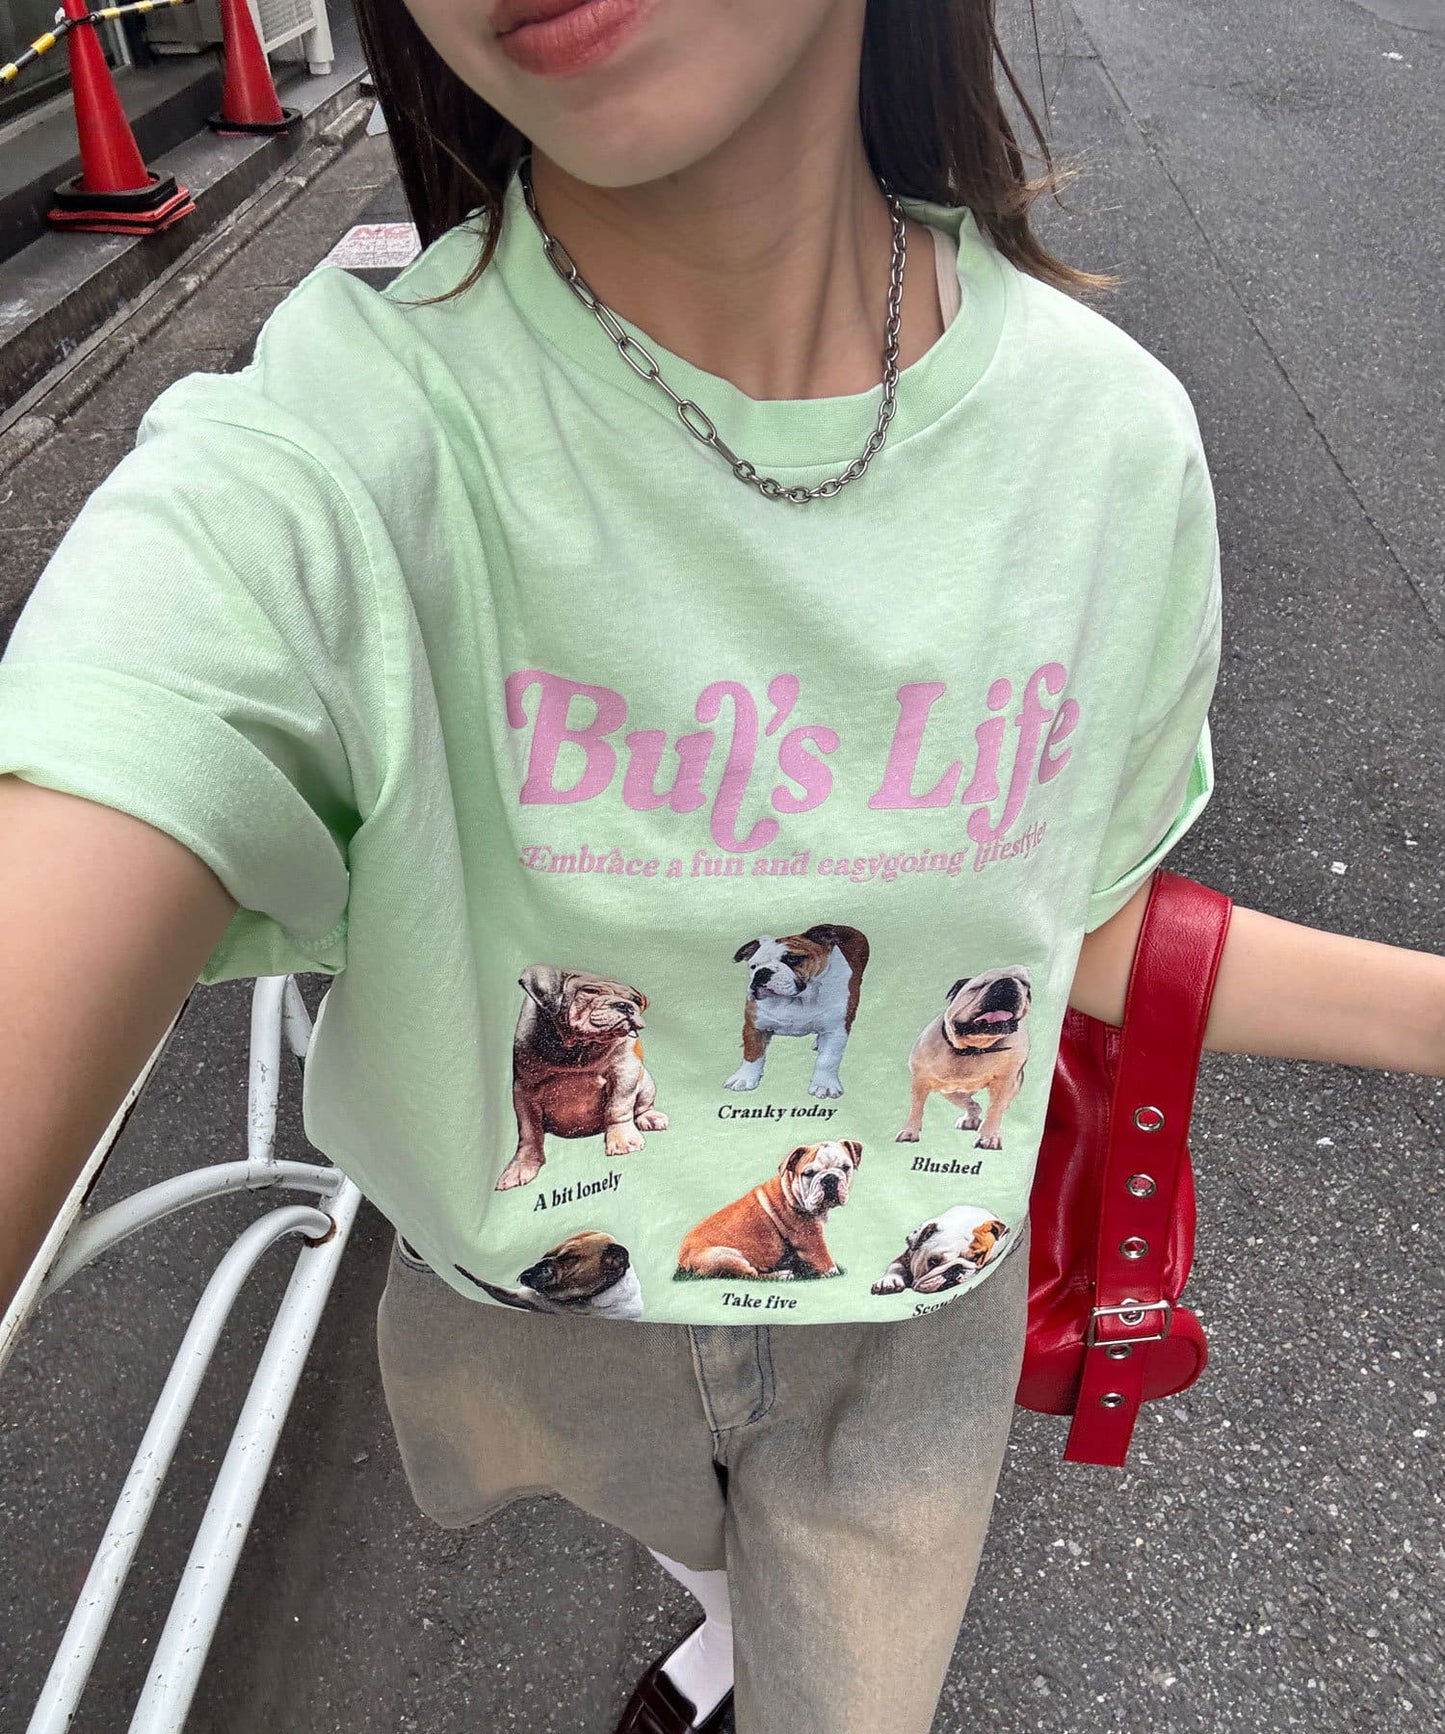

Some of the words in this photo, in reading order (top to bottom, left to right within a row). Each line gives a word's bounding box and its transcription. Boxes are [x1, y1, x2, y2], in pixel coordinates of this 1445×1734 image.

[868, 661, 1080, 843] Life
[519, 844, 659, 877] Embrace
[666, 858, 683, 878] a
[691, 848, 745, 878] fun
[751, 850, 812, 877] and
[818, 847, 970, 884] easygoing
[973, 820, 1047, 873] lifestyle
[718, 1104, 787, 1122] Cranky
[790, 1104, 838, 1121] today
[910, 1156, 983, 1175] Blushed
[533, 1193, 547, 1212] A
[552, 1187, 573, 1208] bit
[576, 1170, 622, 1200] lonely
[722, 1292, 762, 1308] Take
[765, 1295, 798, 1309] five
